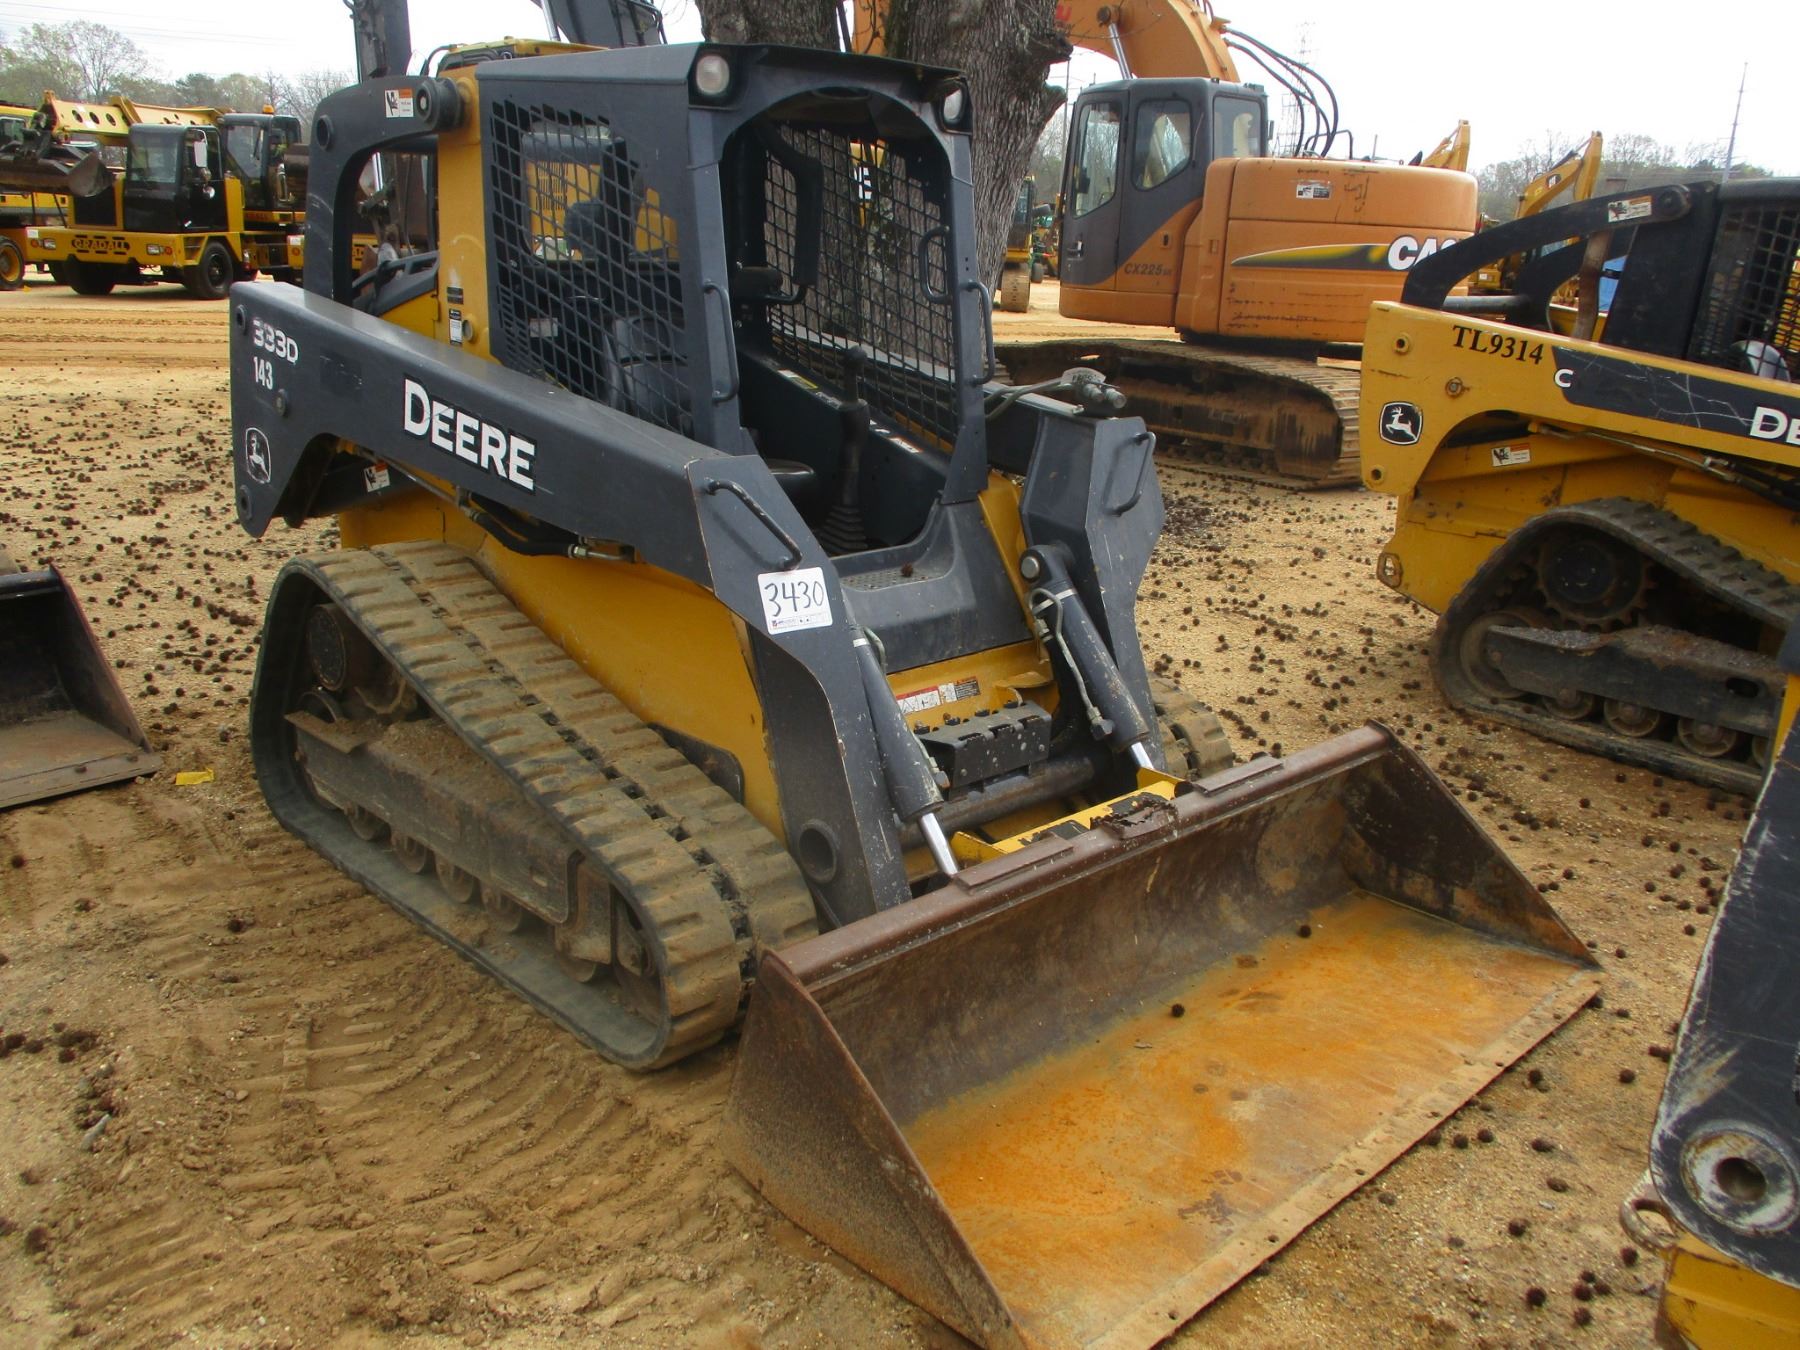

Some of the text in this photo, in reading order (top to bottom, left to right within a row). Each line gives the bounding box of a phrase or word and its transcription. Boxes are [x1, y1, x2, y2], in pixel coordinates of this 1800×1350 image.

[73, 240, 129, 250] GRADALL
[252, 318, 299, 364] 333D
[1453, 325, 1544, 365] TL9314
[253, 357, 274, 390] 143
[404, 378, 535, 491] DEERE
[764, 580, 824, 617] 3430
